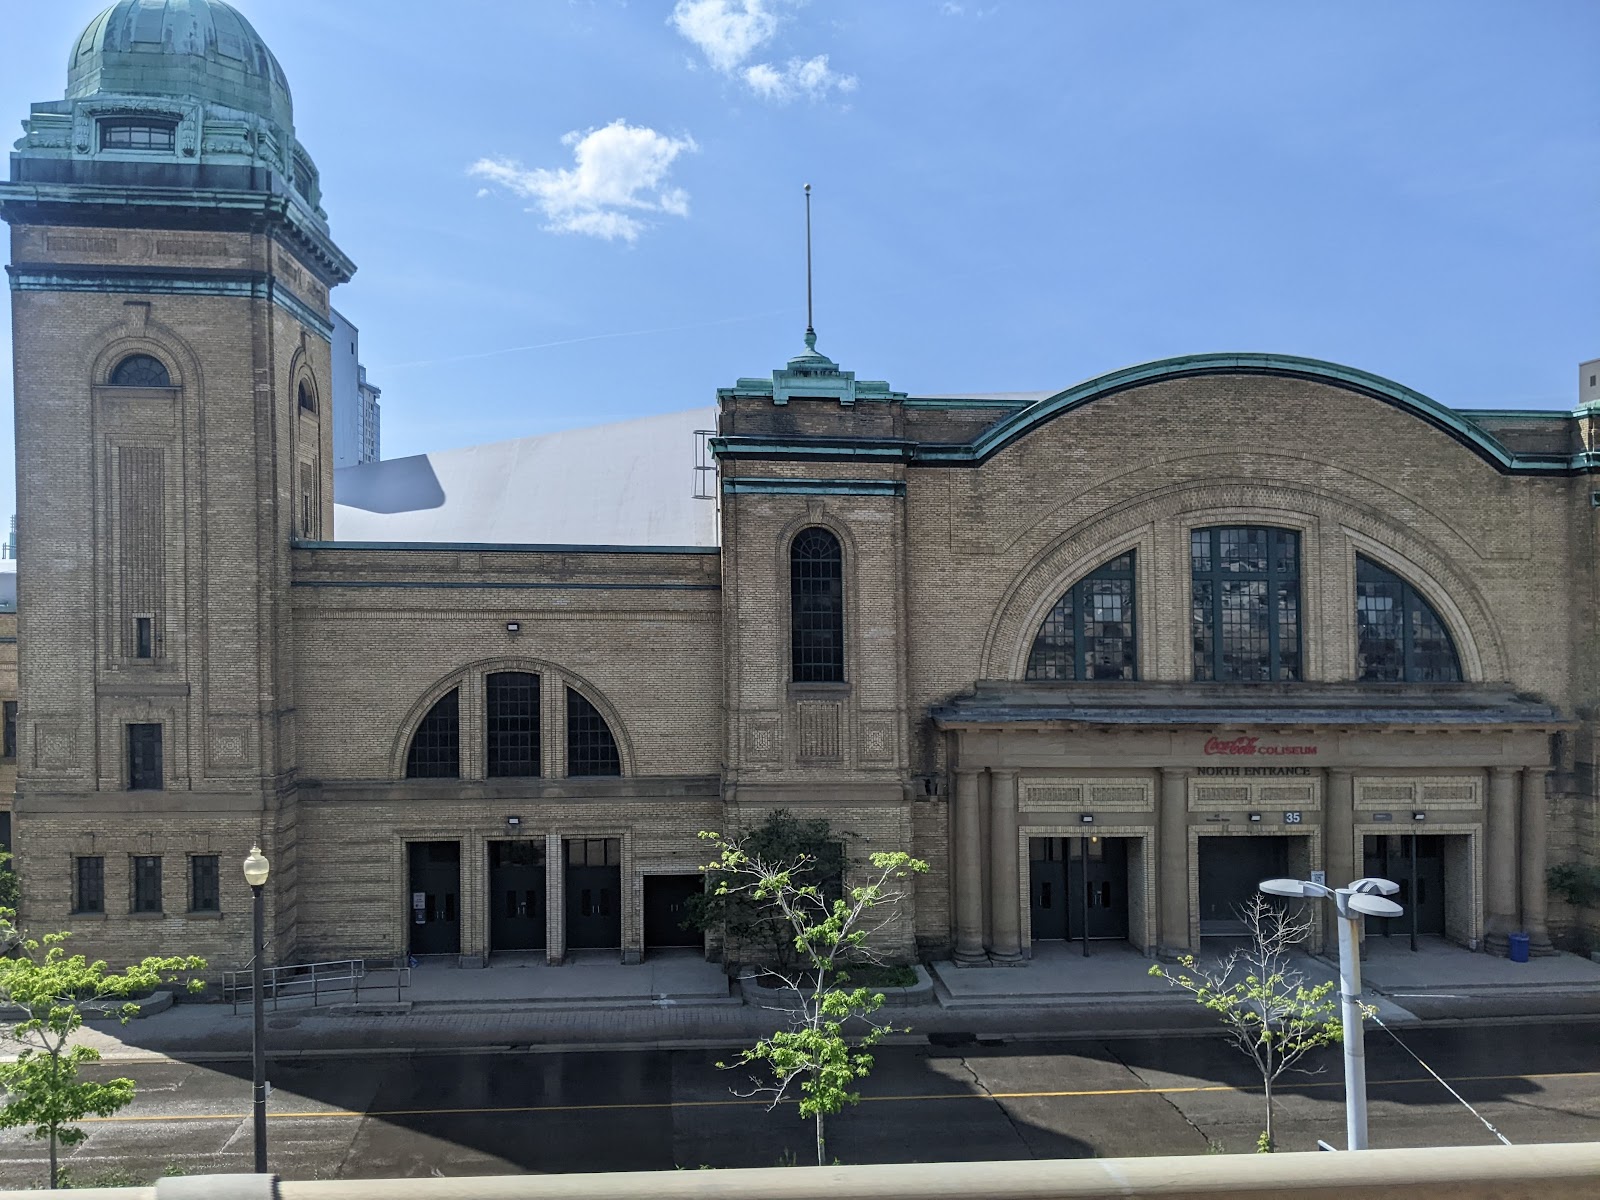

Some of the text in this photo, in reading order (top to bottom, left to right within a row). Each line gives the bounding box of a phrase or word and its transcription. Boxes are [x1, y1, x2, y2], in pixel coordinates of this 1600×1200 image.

[1258, 746, 1317, 755] COLISEUM
[1197, 767, 1311, 776] NORTH ENTRANCE
[1285, 812, 1301, 823] 35
